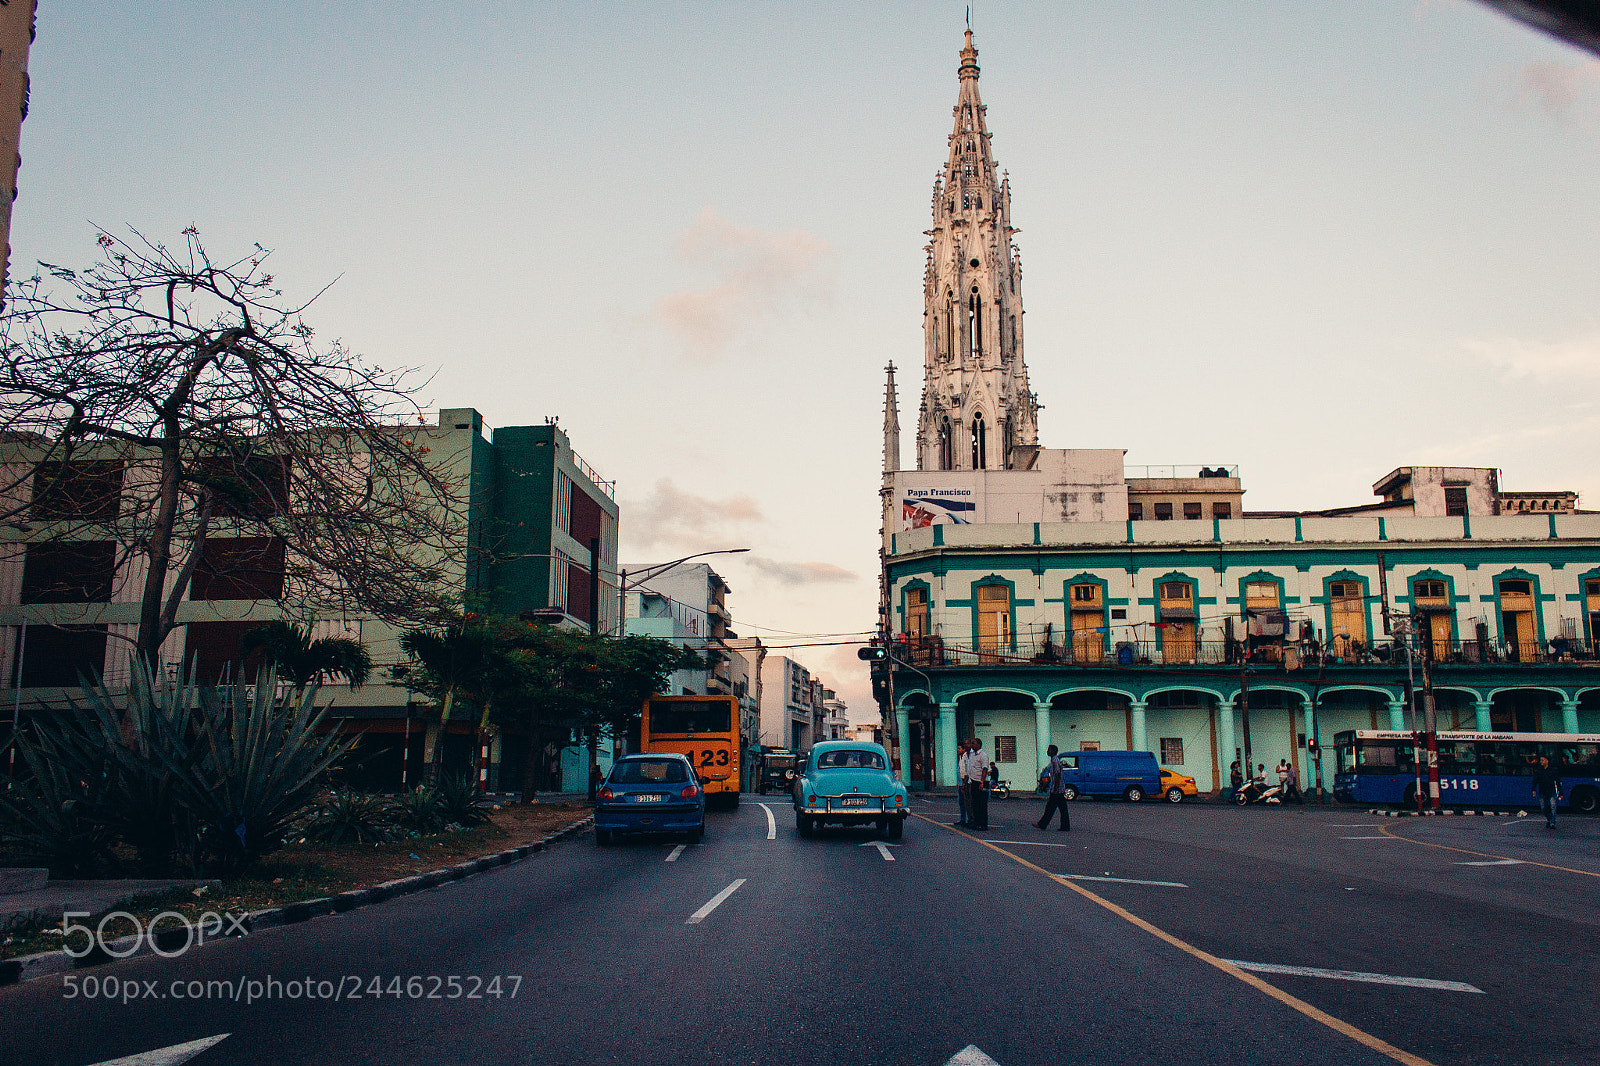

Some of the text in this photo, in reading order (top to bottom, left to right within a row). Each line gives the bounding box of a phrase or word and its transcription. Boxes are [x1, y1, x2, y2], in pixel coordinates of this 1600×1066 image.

[907, 488, 971, 497] Papa Francisco
[1440, 778, 1479, 790] 5118
